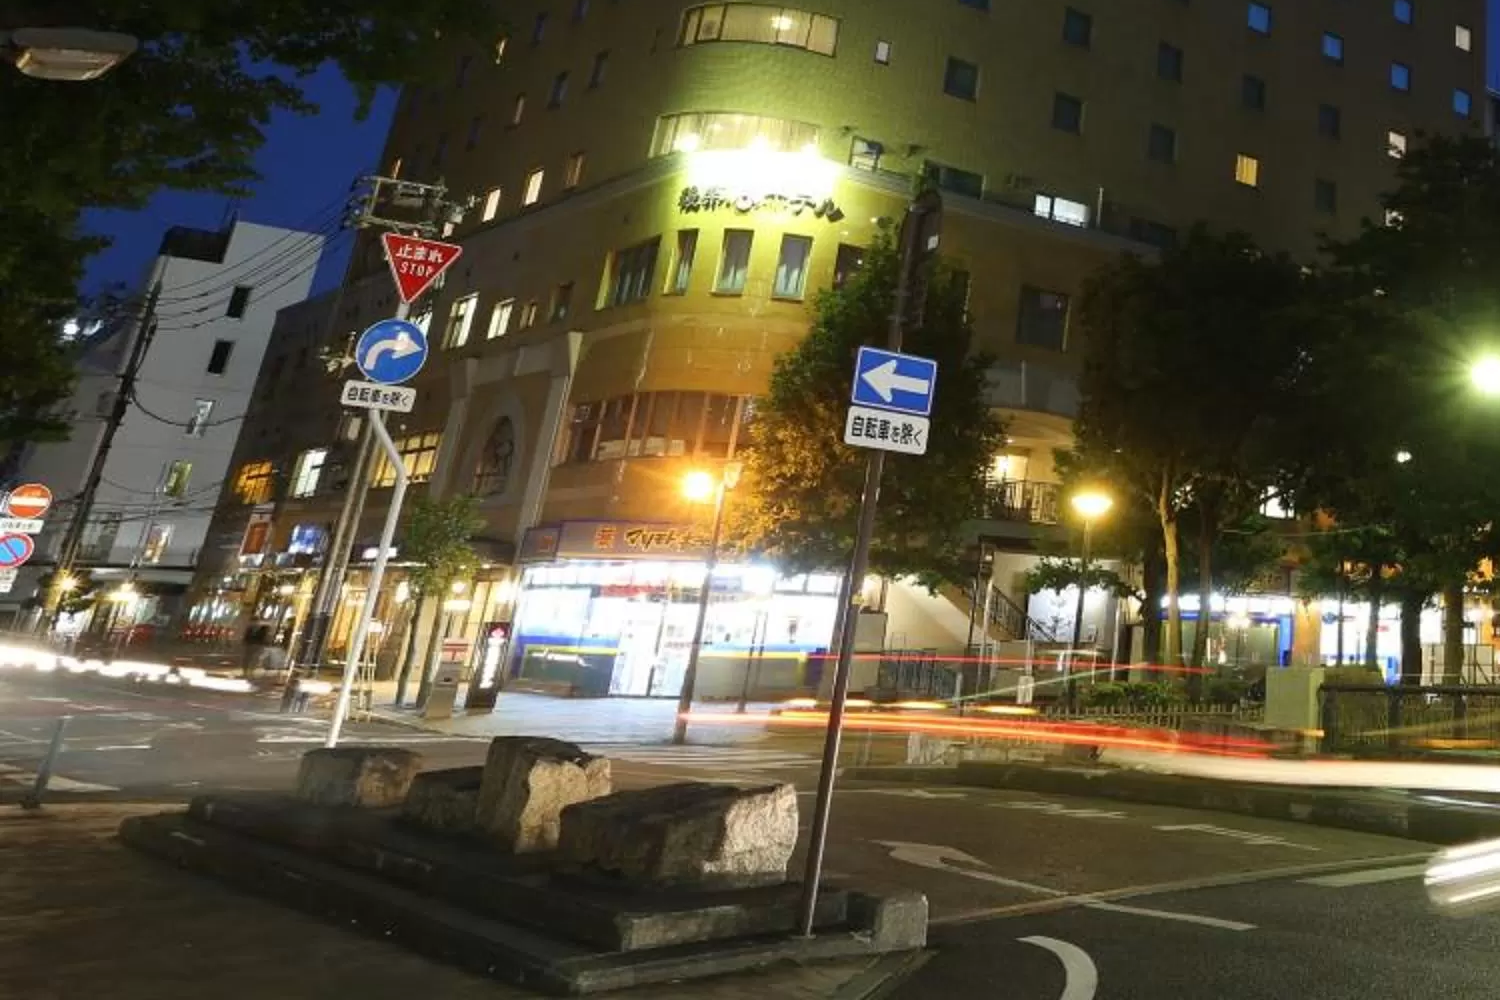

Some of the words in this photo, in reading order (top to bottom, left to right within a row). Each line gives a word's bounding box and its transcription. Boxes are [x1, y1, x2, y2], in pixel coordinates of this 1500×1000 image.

[395, 244, 444, 264] 止まれ
[399, 261, 434, 279] STOP
[347, 386, 413, 408] 自転車を除く
[851, 415, 923, 447] 自転車を除く
